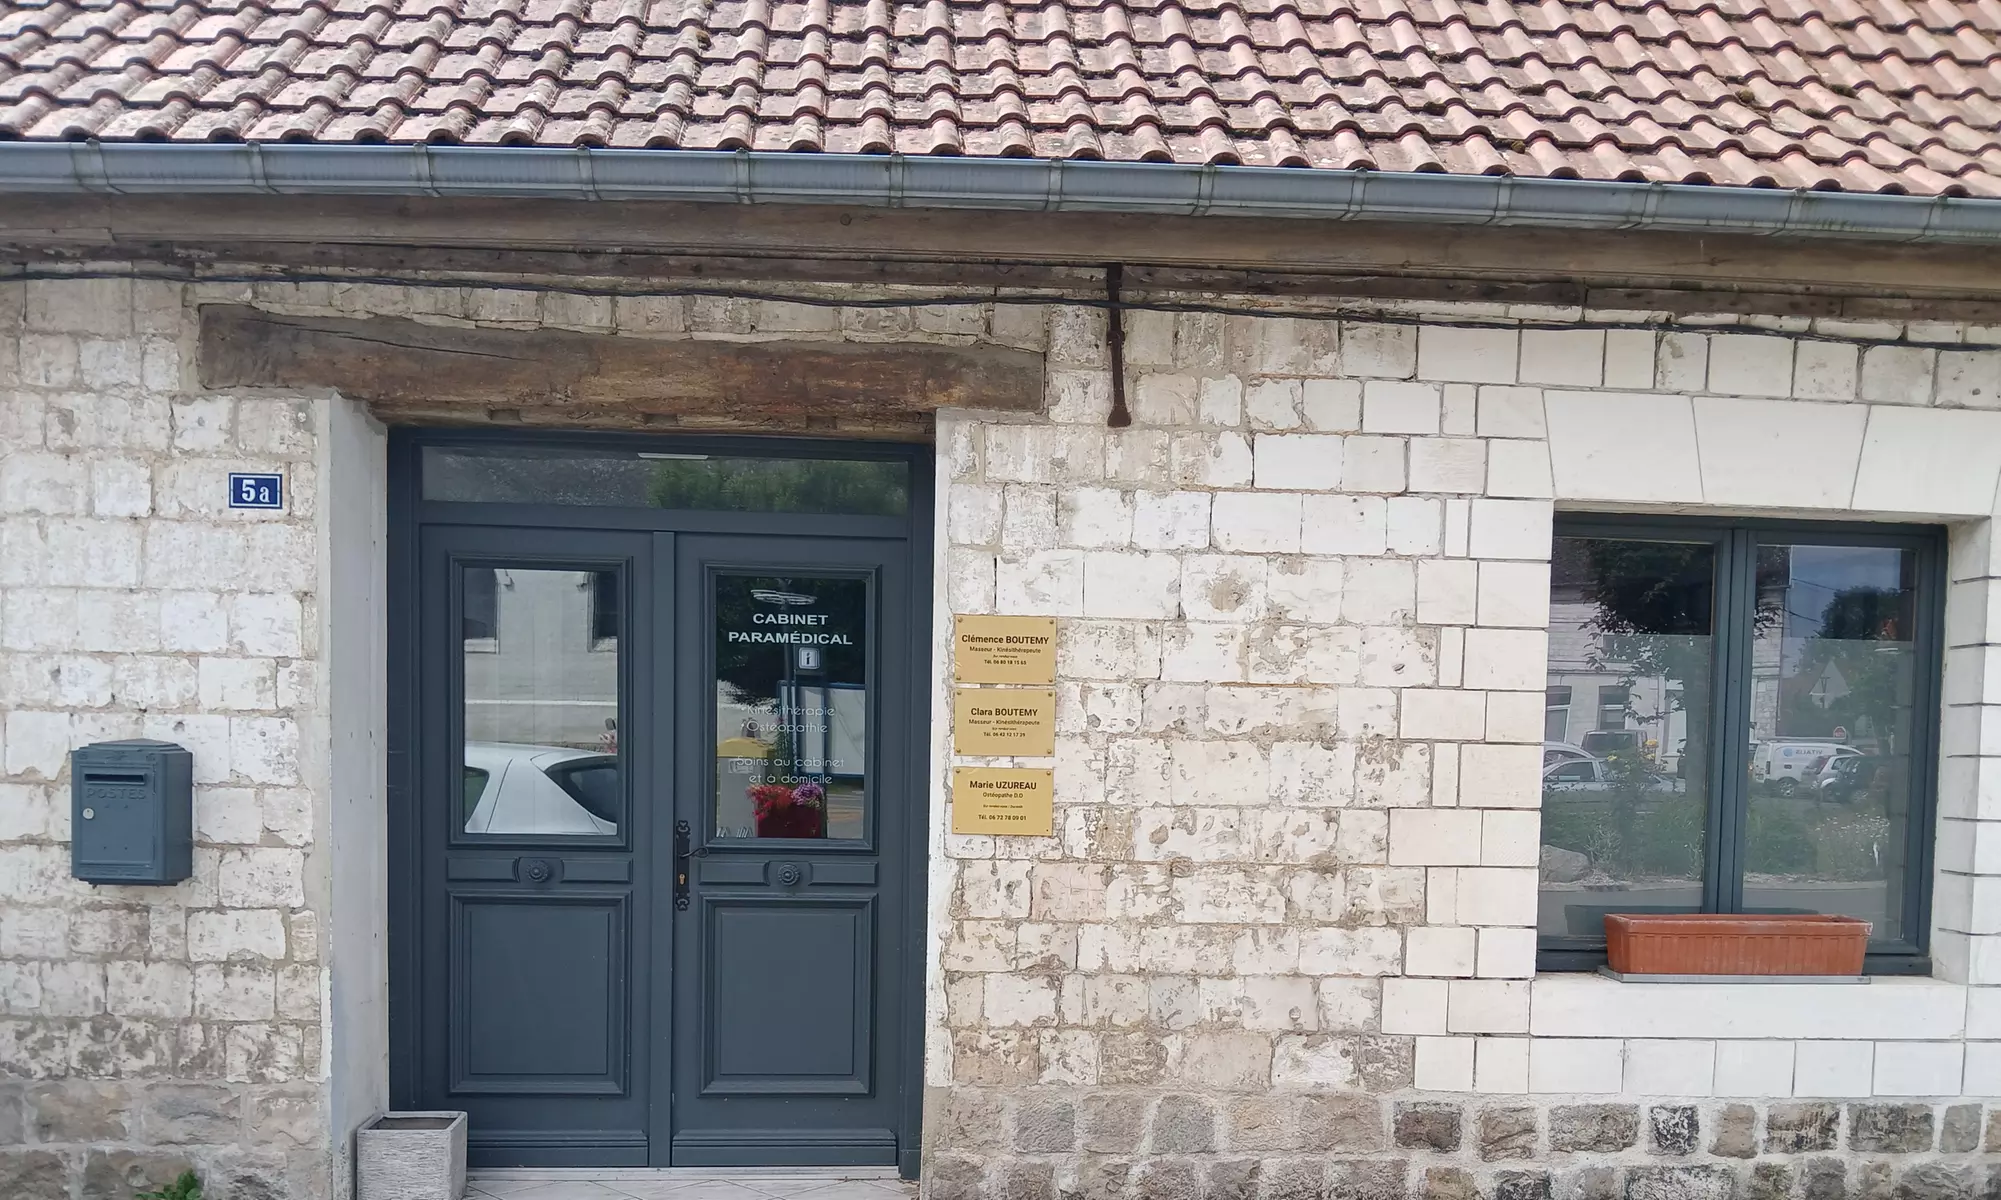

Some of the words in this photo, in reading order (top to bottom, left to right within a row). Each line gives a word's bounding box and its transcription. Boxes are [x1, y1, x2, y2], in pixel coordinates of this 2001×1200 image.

[242, 479, 270, 502] 5a
[752, 613, 828, 626] CABINET
[728, 631, 853, 645] PARAMÉDICAL
[961, 634, 1004, 644] Clémence
[1005, 636, 1049, 644] BOUTEMY
[747, 704, 835, 717] Kinésithérapie
[970, 708, 993, 716] Clara
[995, 708, 1038, 716] BOUTEMY
[746, 720, 828, 733] Ostéopathie
[736, 755, 769, 767] Soins
[773, 759, 791, 767] au
[794, 756, 845, 768] cabinet
[749, 773, 762, 784] et
[767, 773, 776, 784] à
[780, 774, 833, 785] domicile
[969, 780, 994, 788] Marie
[995, 782, 1037, 790] UZUREAU
[86, 788, 147, 800] POSTES
